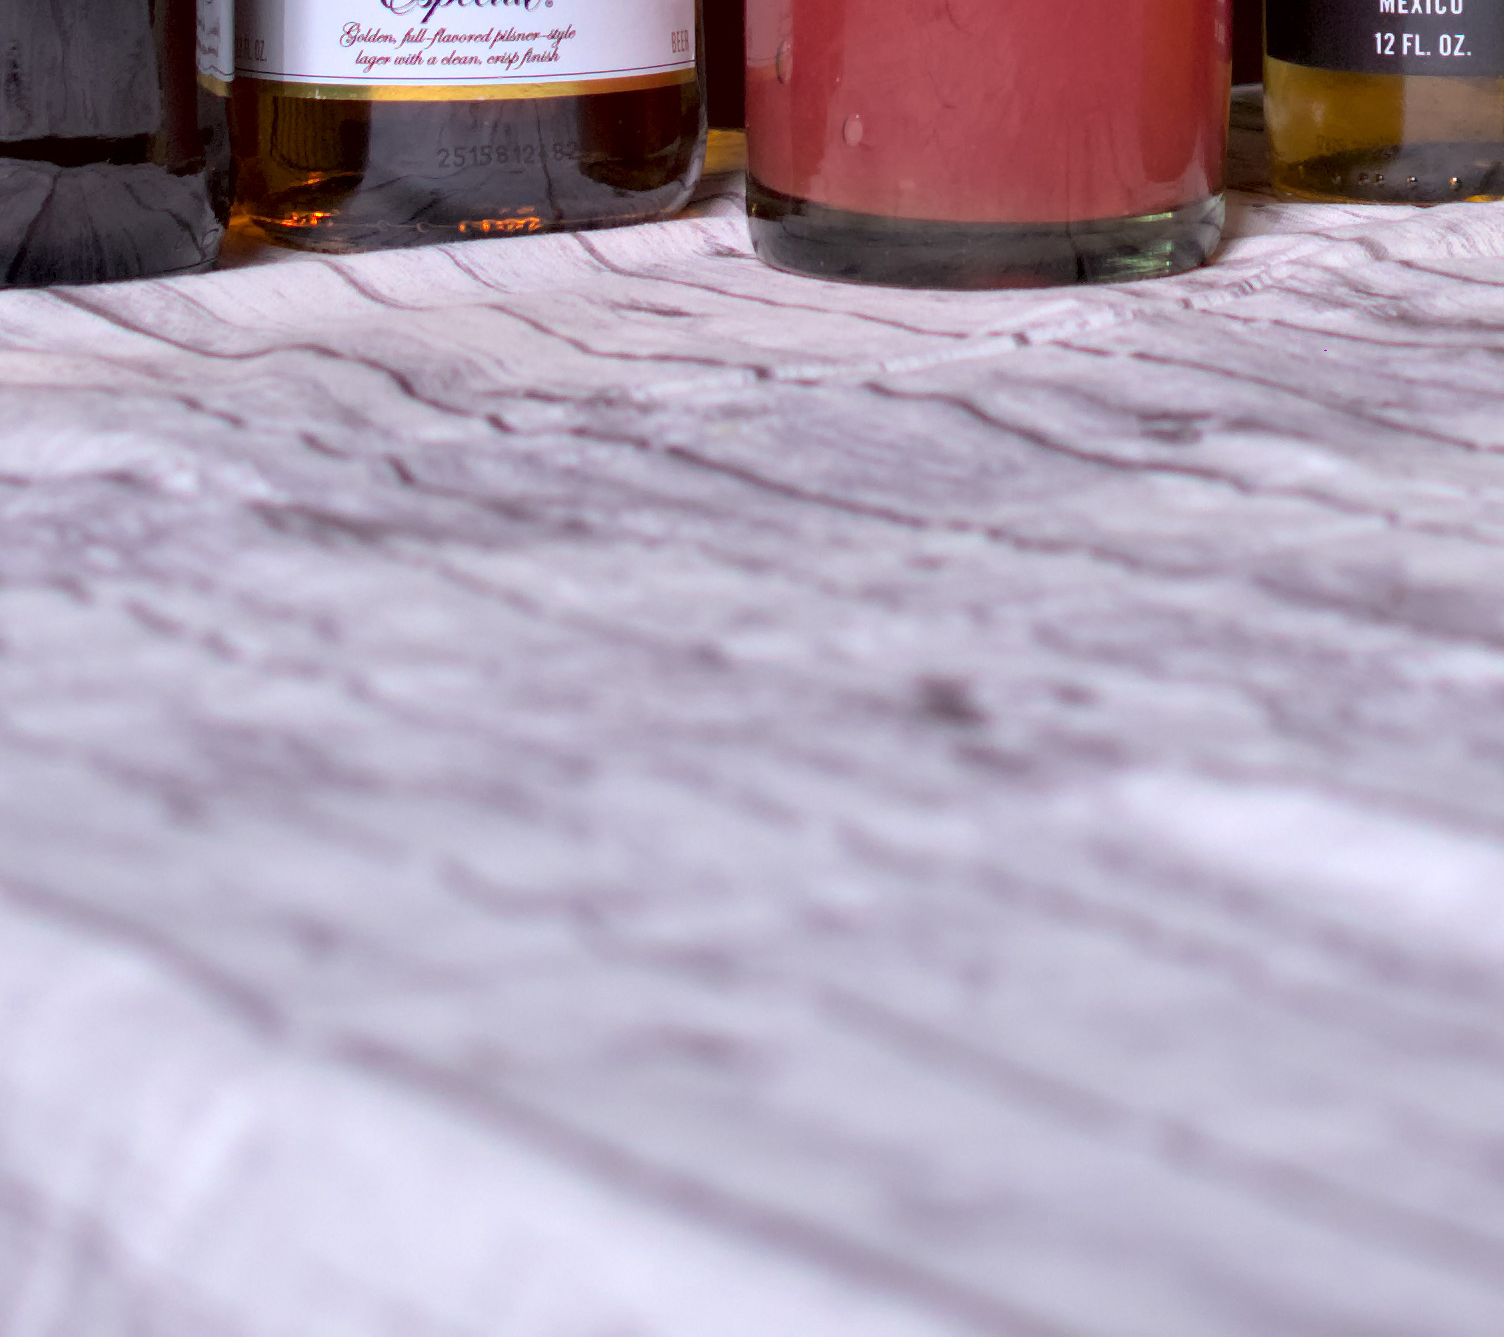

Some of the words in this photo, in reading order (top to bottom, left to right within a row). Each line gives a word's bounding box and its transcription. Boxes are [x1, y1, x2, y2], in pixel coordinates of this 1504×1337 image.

[339, 21, 397, 48] Golden,
[394, 27, 495, 50] full-flavored
[489, 24, 577, 49] pilsner-style
[671, 30, 691, 55] BEER
[1374, 32, 1396, 55] 12
[1402, 34, 1431, 56] FL.
[1439, 34, 1473, 56] OZ.
[354, 49, 392, 73] lager
[394, 50, 424, 66] with
[426, 54, 439, 66] a
[440, 49, 483, 66] clean,
[486, 52, 520, 72] crisp
[513, 47, 561, 71] finish
